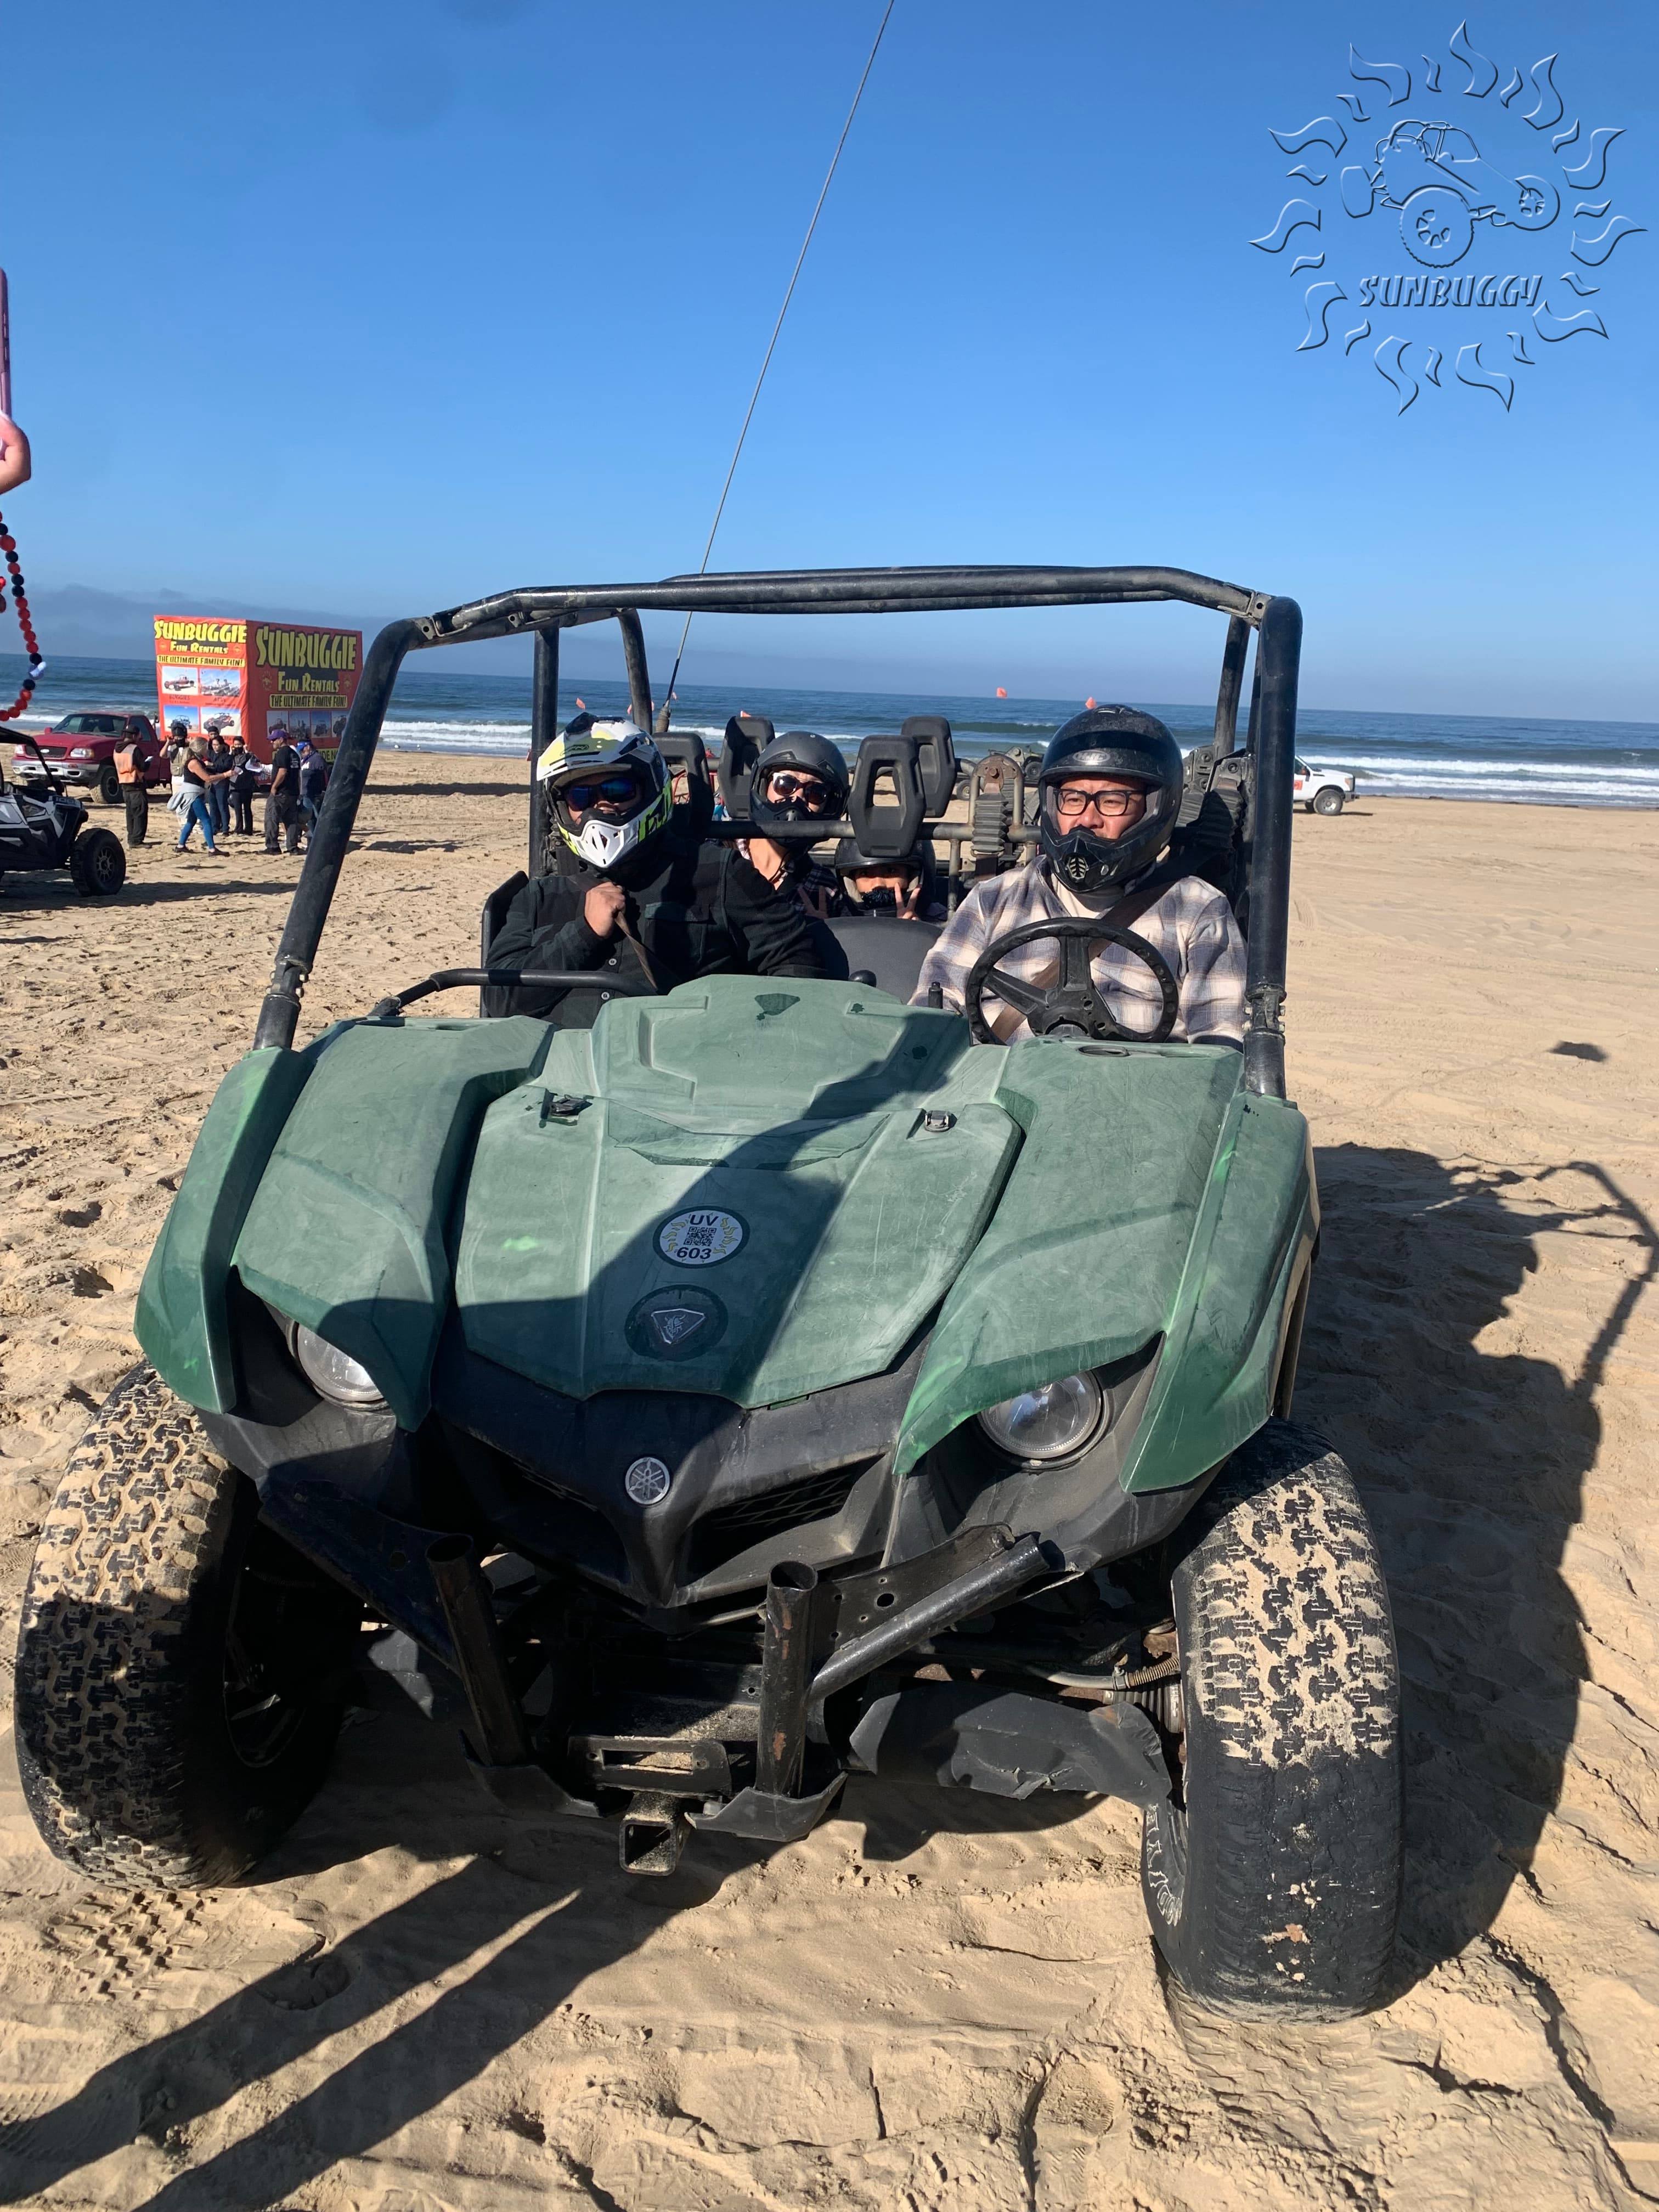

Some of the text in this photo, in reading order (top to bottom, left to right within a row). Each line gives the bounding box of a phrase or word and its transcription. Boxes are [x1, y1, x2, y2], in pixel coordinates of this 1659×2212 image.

[154, 619, 247, 644] SUNBUGGIE
[170, 641, 229, 654] FUN RENTALS
[256, 624, 357, 670] SUNBUGGIE
[278, 671, 340, 692] FUN RENTALS
[271, 695, 346, 707] THE ULTIMATE FAMILY FUN!
[690, 1215, 719, 1226] UV
[676, 1246, 712, 1260] 603
